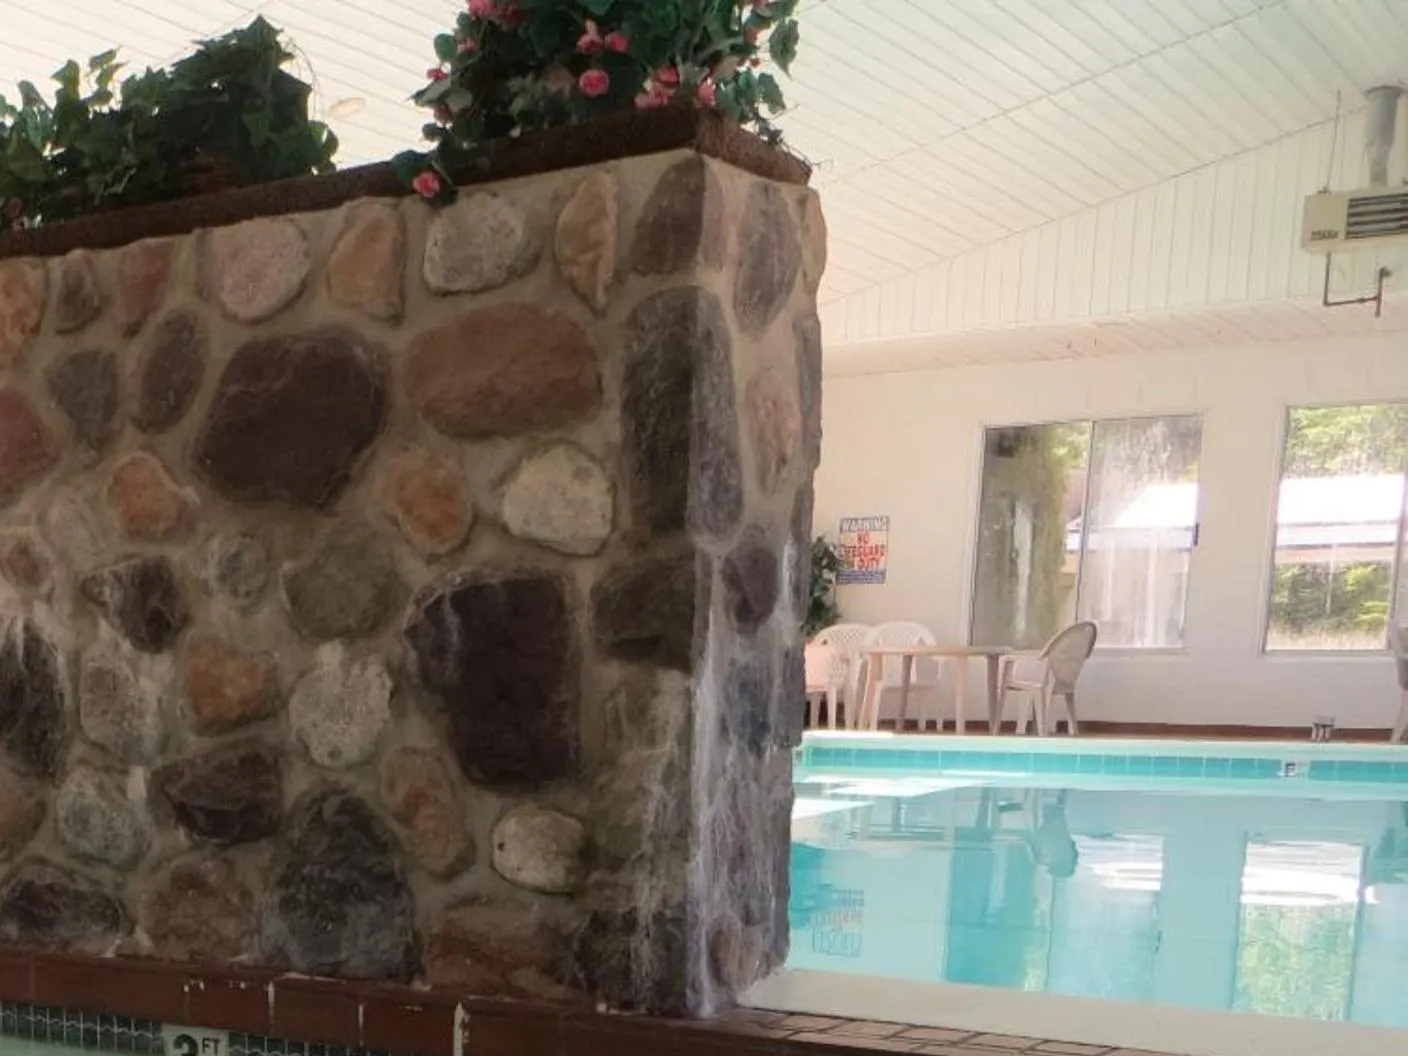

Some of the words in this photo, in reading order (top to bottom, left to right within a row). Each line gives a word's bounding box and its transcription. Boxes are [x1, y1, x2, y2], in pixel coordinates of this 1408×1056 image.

[842, 517, 887, 531] WARNING
[857, 531, 870, 544] NO
[201, 1036, 221, 1055] FT
